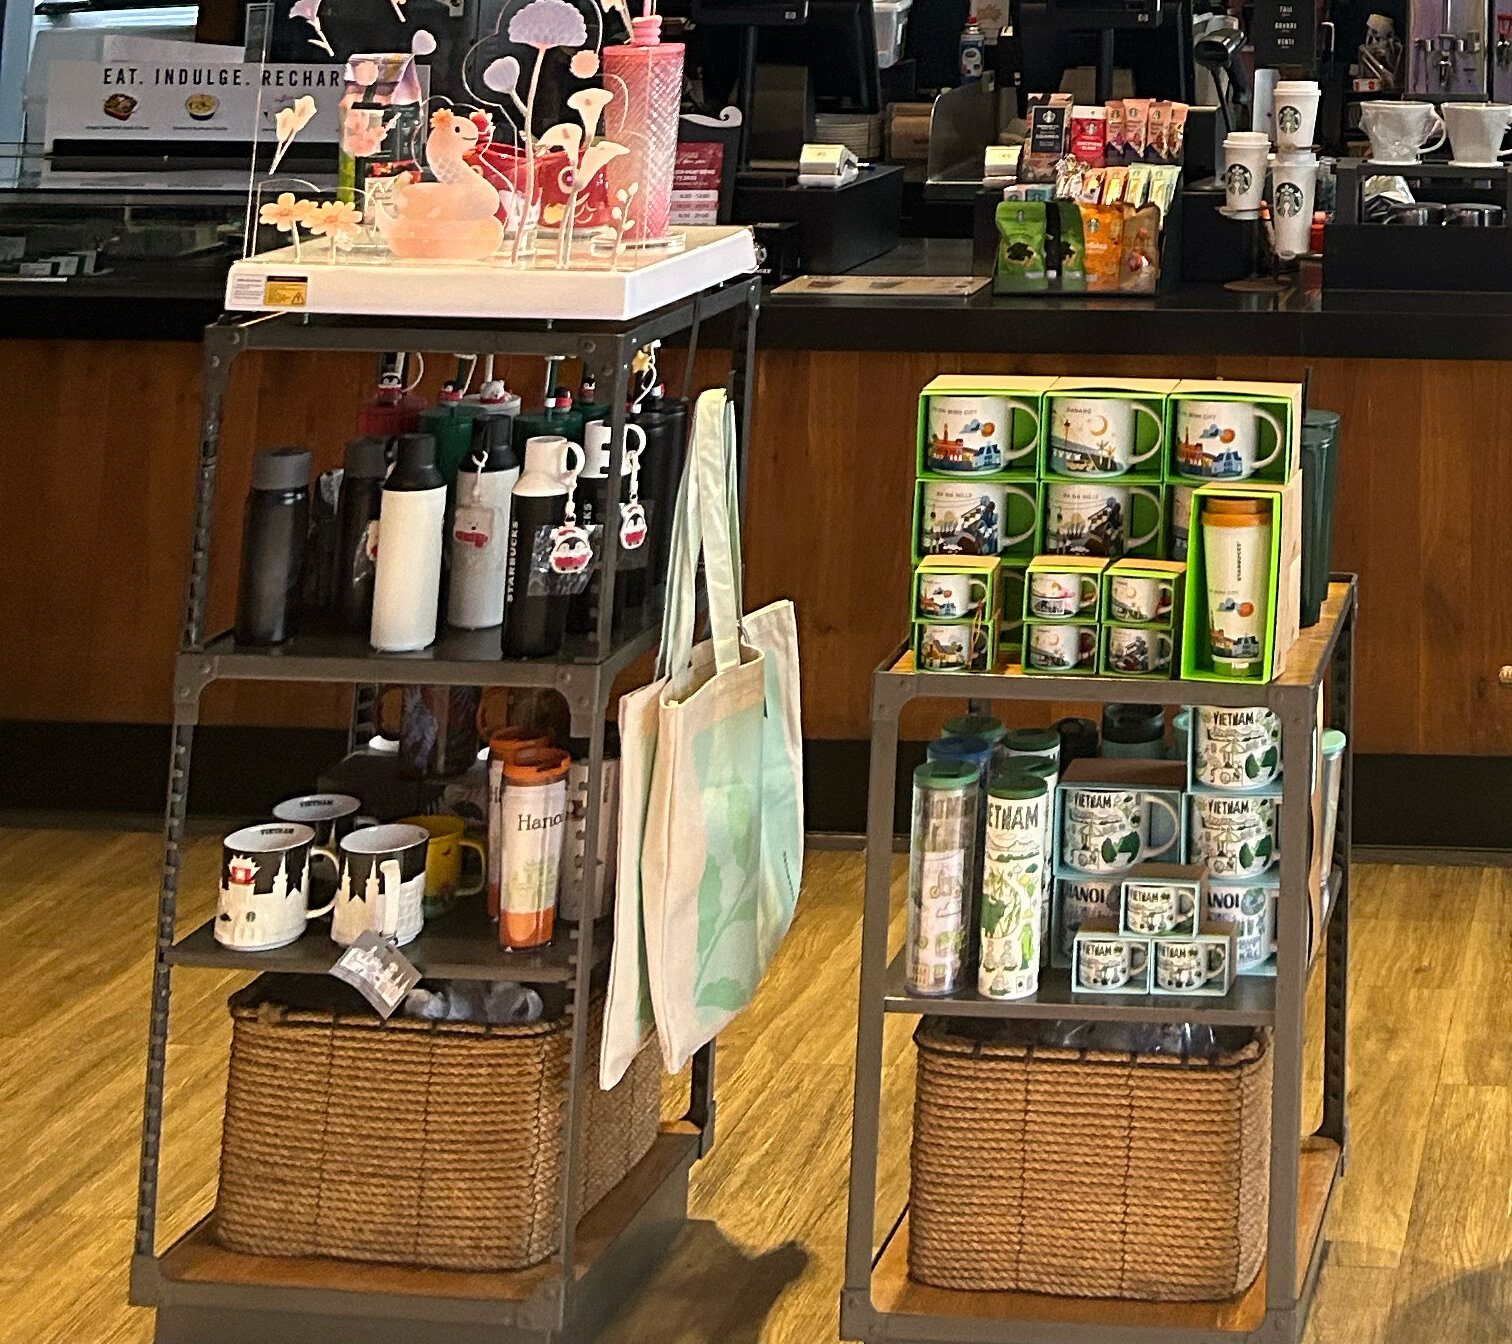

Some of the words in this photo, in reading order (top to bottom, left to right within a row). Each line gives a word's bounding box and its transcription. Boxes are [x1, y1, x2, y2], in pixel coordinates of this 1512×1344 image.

[103, 68, 144, 85] EAT.
[155, 68, 251, 86] INDULGE.
[260, 69, 341, 87] RECHAR
[506, 520, 519, 603] STARBUCKS
[1212, 711, 1255, 727] VIETNAM
[1073, 793, 1112, 810] VIETNAM
[1207, 798, 1250, 815] VIETNAM
[517, 812, 565, 832] Hano
[1206, 891, 1241, 910] ANOI
